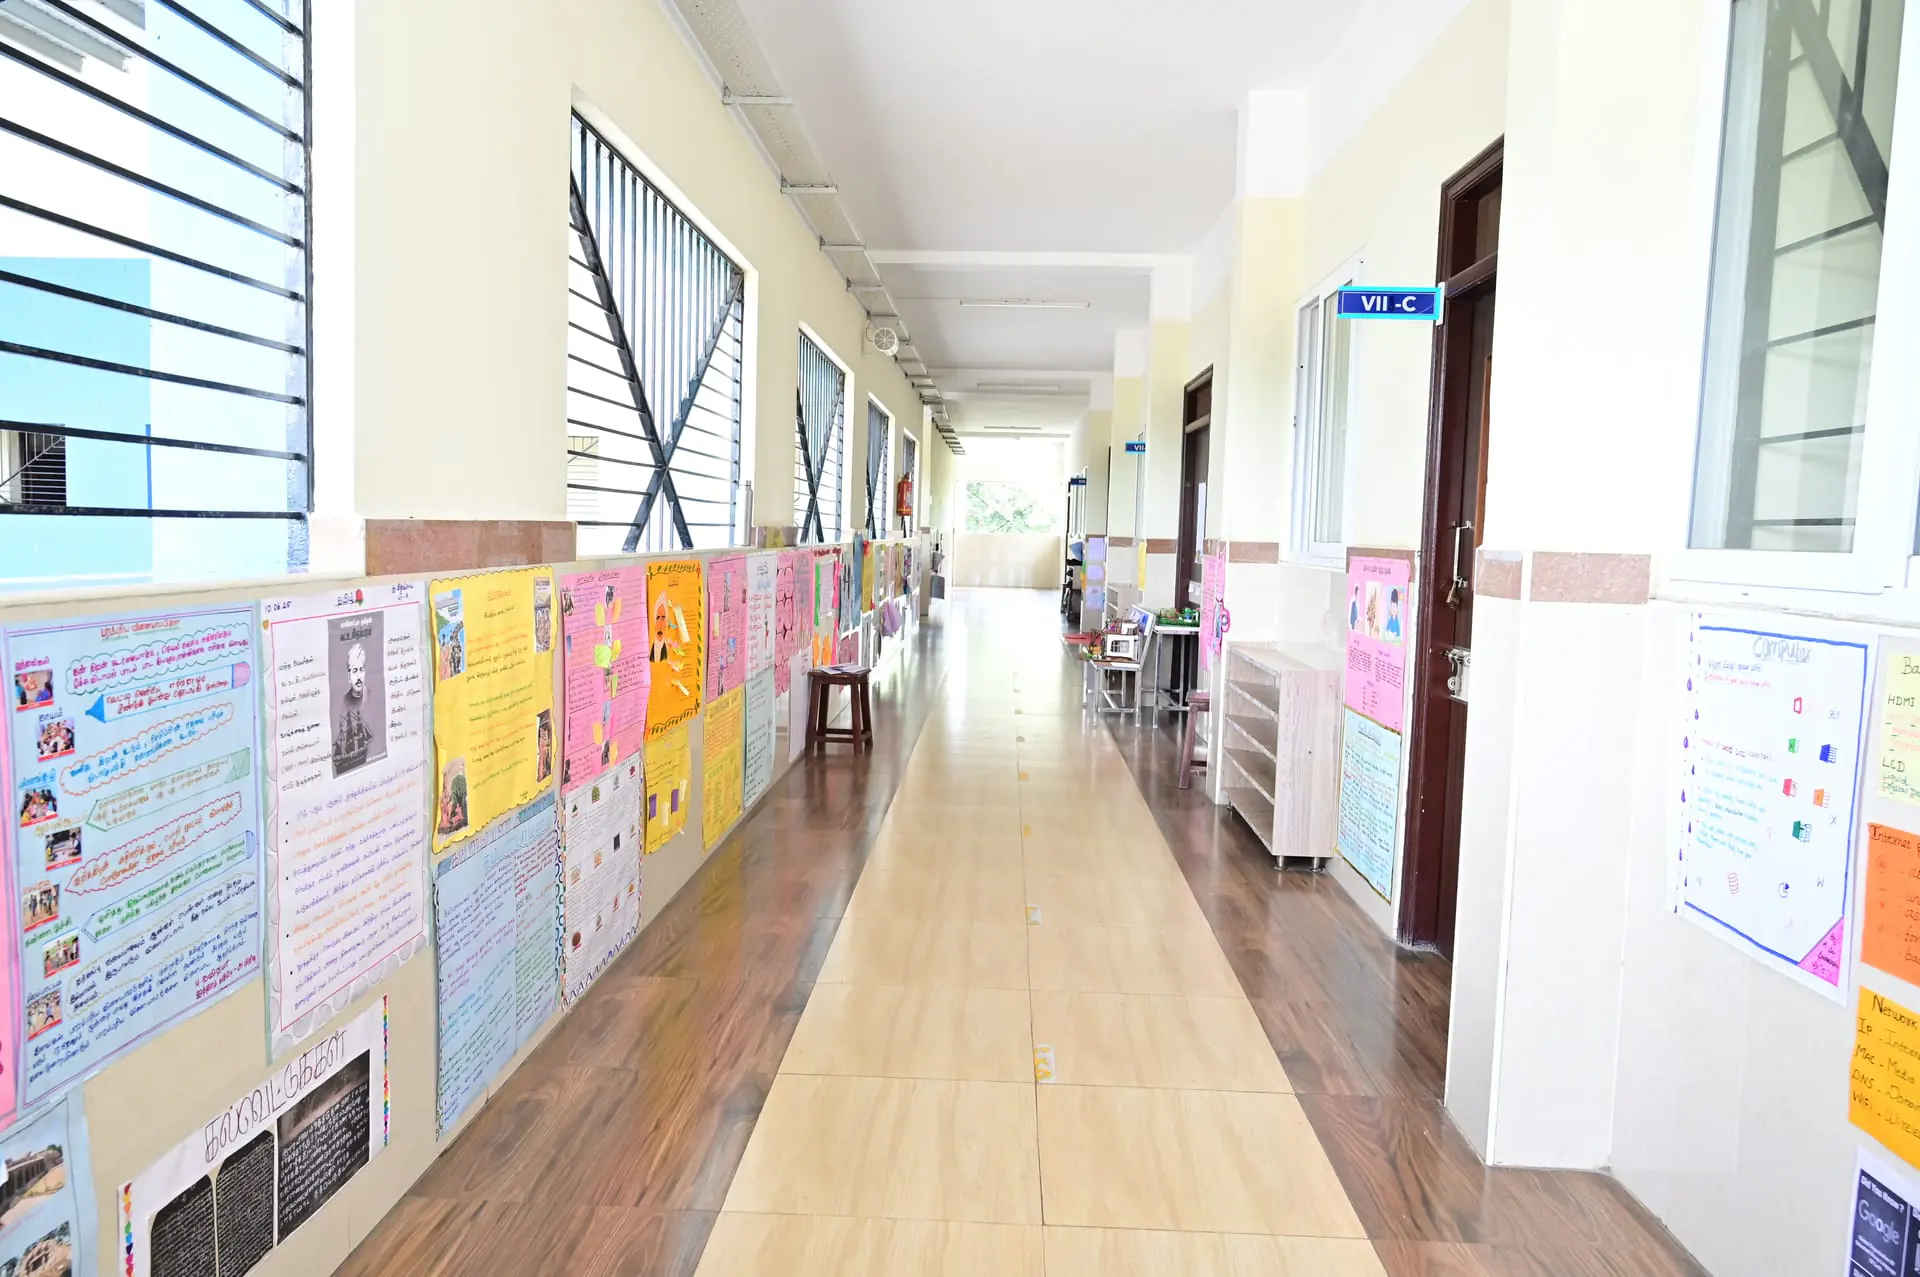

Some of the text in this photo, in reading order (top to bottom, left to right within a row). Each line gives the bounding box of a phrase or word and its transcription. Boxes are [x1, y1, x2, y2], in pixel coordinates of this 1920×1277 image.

[1361, 296, 1388, 311] VII
[1887, 693, 1915, 707] HDMI
[1882, 757, 1906, 773] LCD
[1852, 1069, 1875, 1090] DNS
[1858, 1199, 1900, 1245] Google
